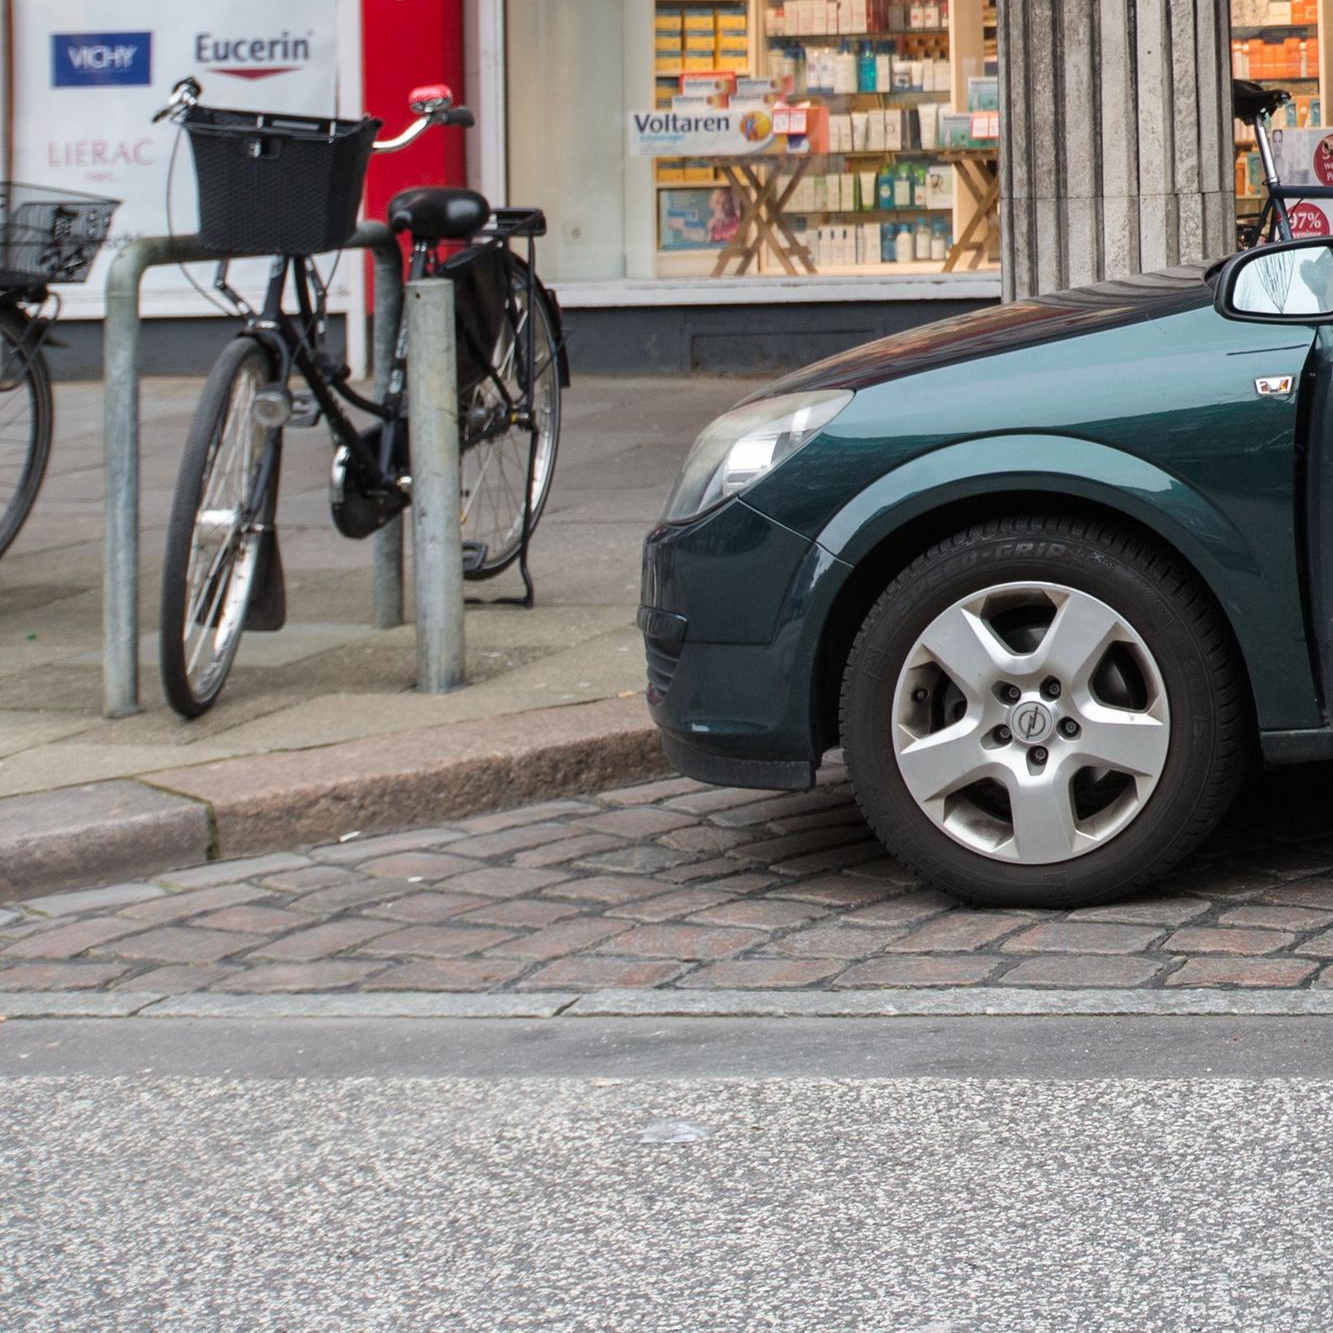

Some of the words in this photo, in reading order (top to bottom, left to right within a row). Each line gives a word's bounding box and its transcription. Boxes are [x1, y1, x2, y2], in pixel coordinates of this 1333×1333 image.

[68, 44, 138, 69] VICHY
[195, 31, 310, 63] Eucerin
[634, 114, 730, 133] Voltaren
[48, 138, 156, 167] LIERAC
[1288, 212, 1322, 229] 97%
